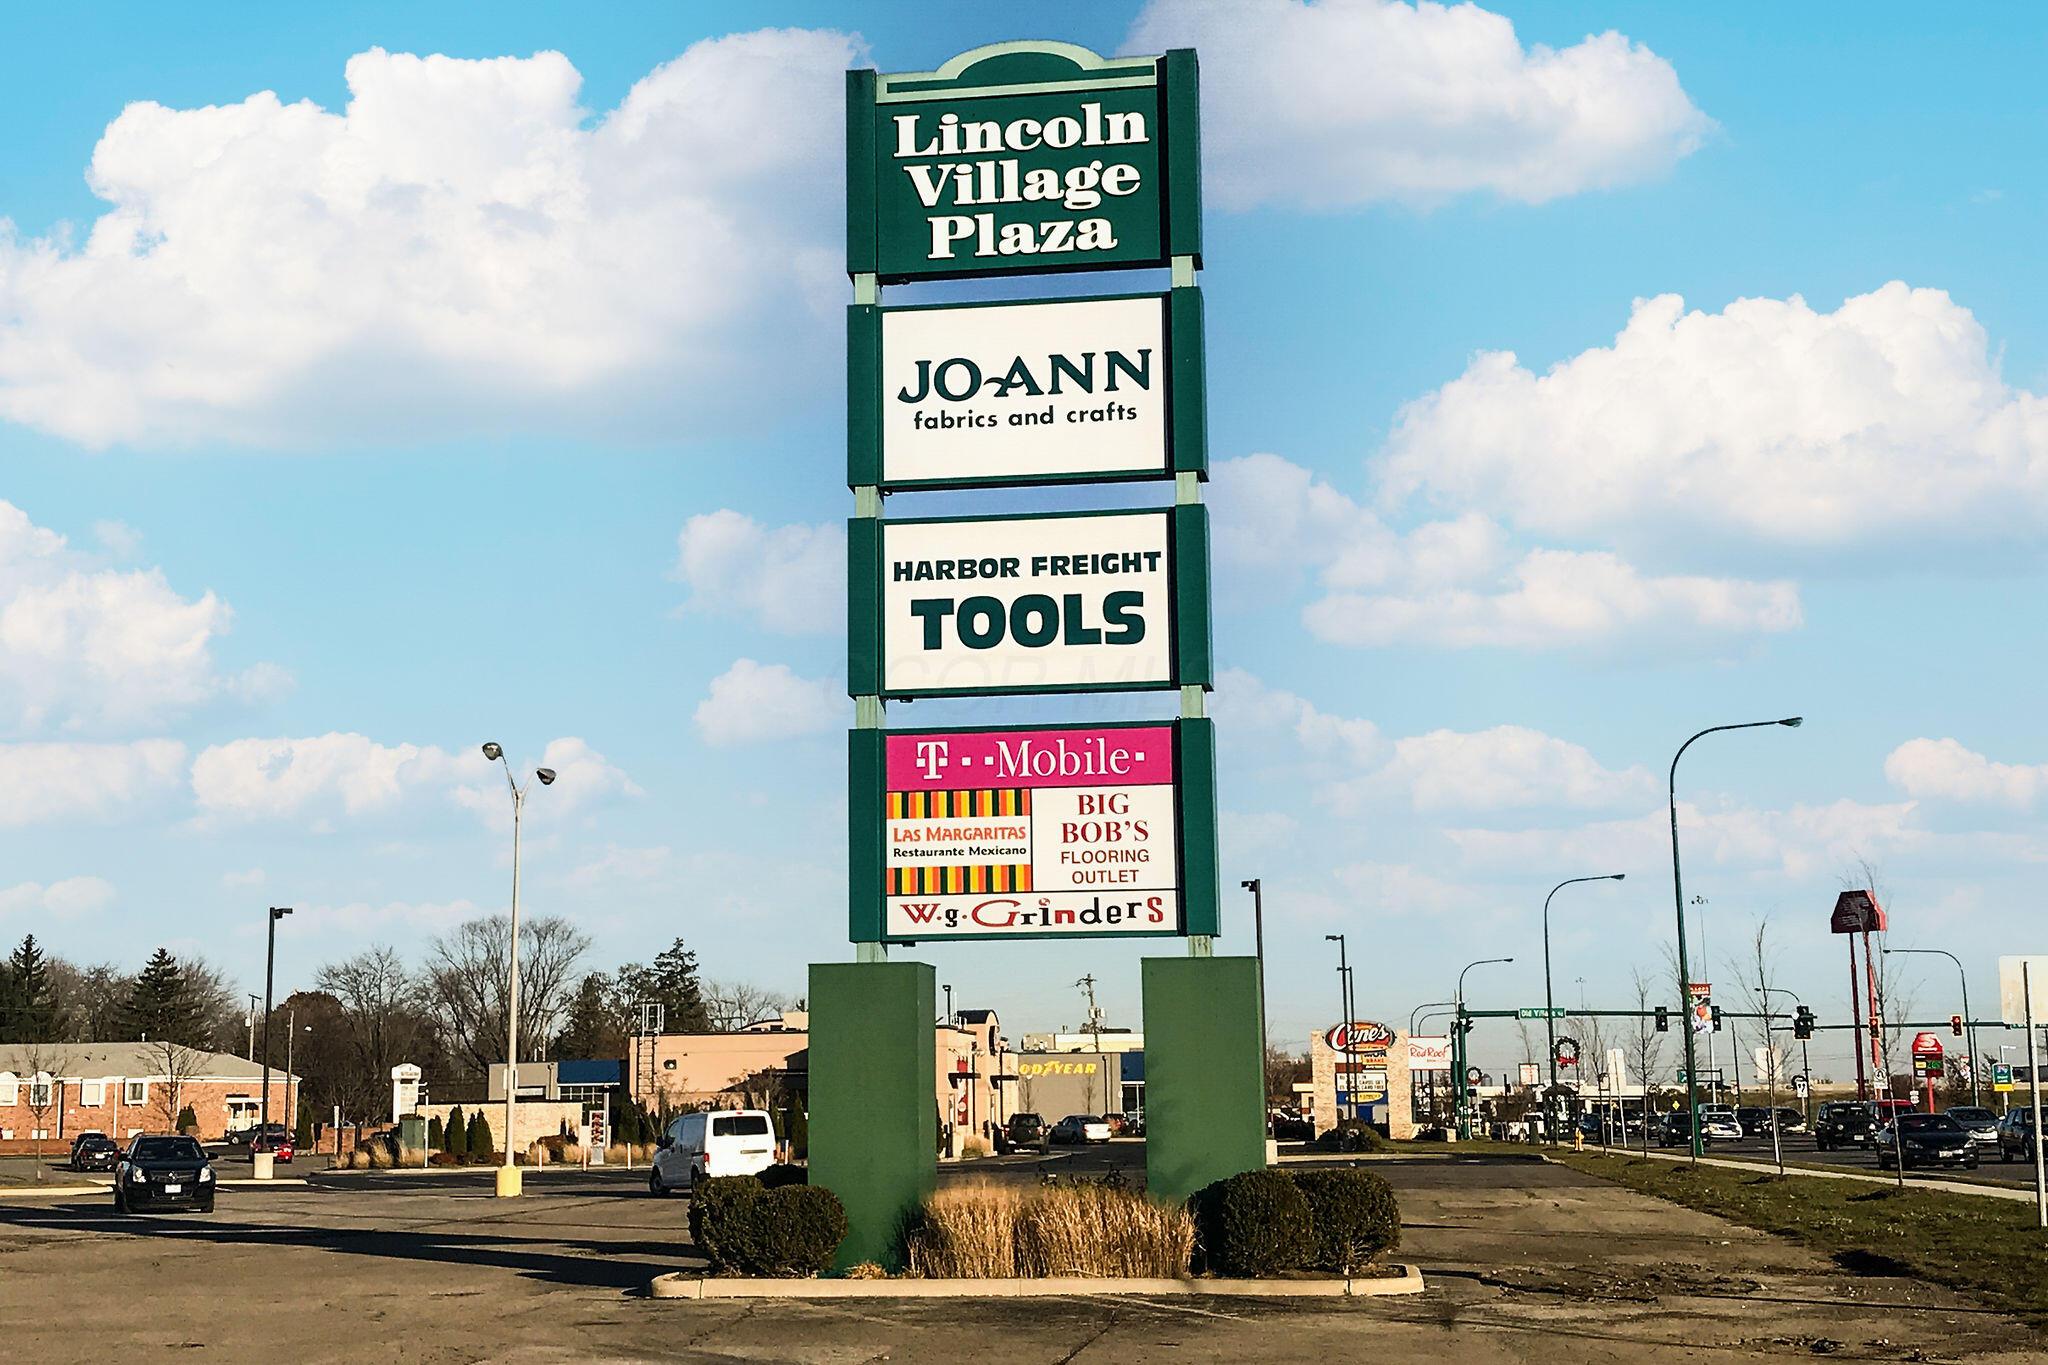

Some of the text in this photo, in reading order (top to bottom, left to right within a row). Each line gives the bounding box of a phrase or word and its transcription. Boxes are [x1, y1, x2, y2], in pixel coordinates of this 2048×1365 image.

[893, 102, 1149, 158] Lincoln
[903, 159, 1141, 209] Village
[927, 213, 1118, 259] Plaza
[913, 402, 1138, 430] fabrics and crafts
[893, 551, 1162, 582] HARBOR FREIGHT
[911, 590, 1146, 650] TOOLS
[1077, 793, 1129, 816] BIG
[893, 825, 1026, 842] LAS MARGARITAS
[1061, 820, 1149, 844] BOB'S
[893, 845, 1027, 858] Restaurante Mexicano
[1060, 849, 1150, 865] FLOORING
[1071, 869, 1139, 885] OUTLET
